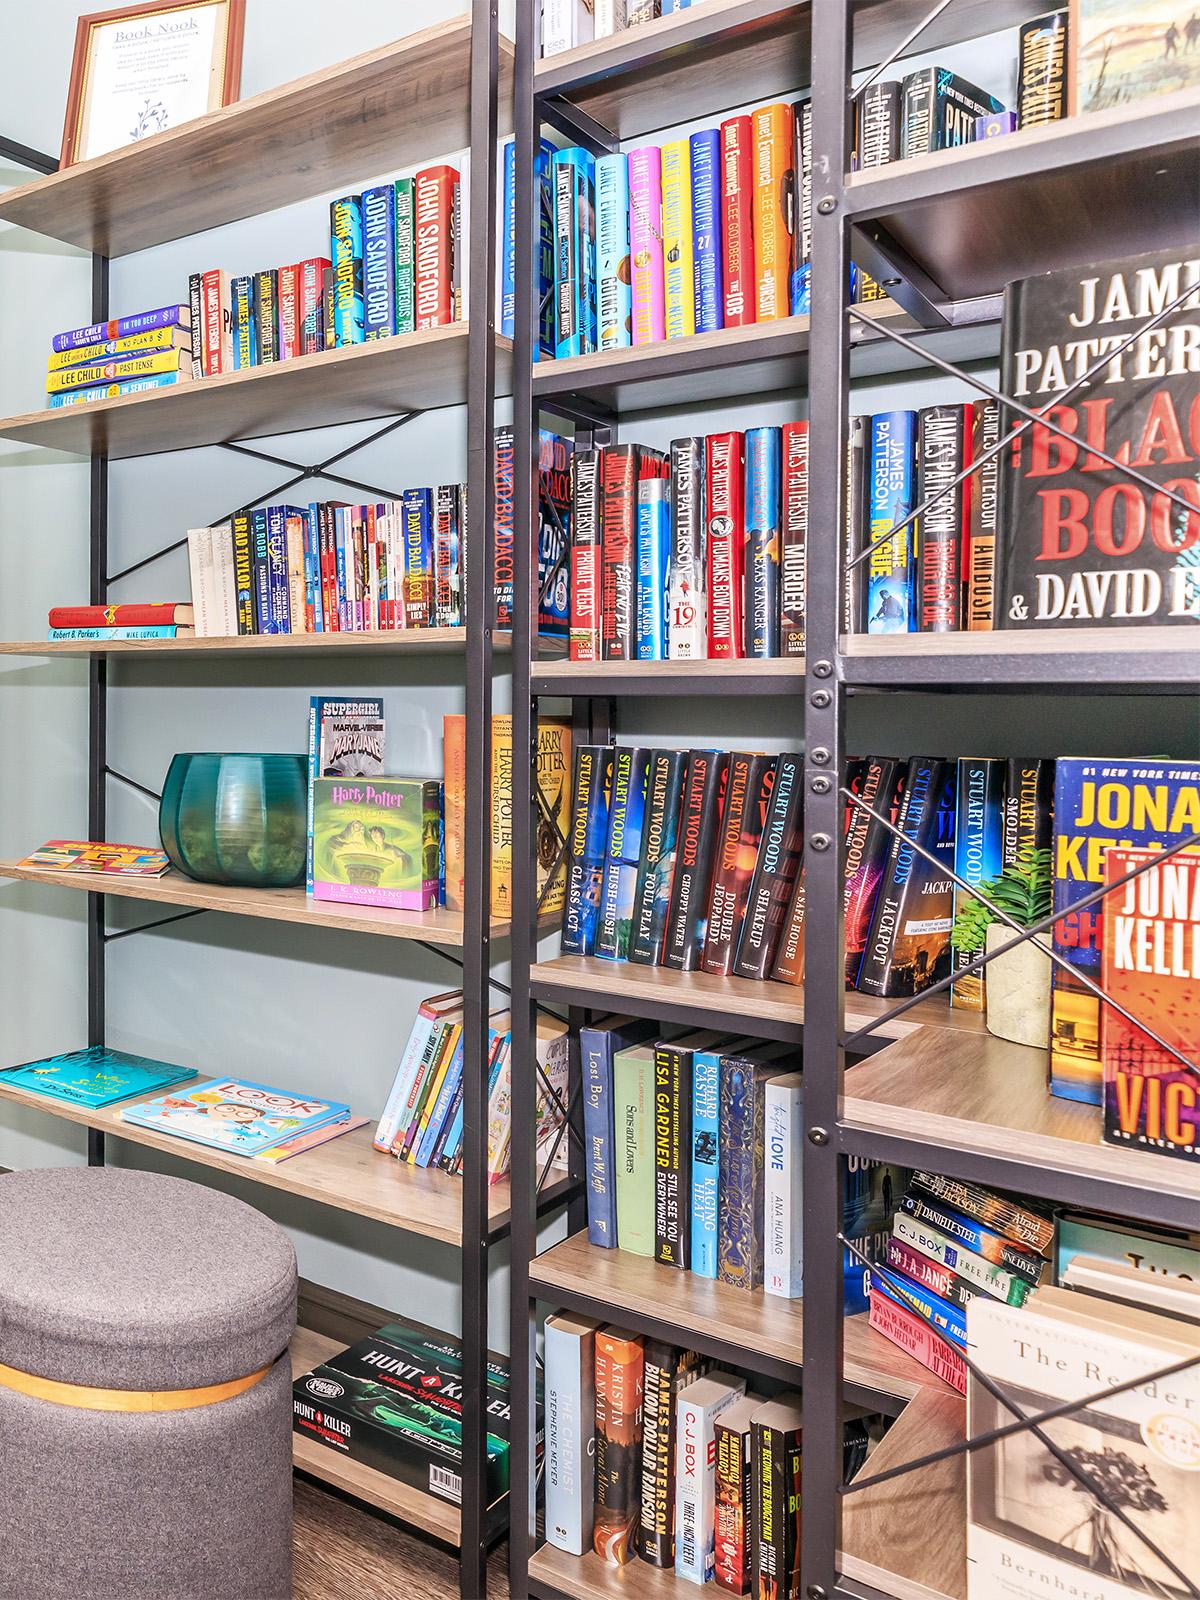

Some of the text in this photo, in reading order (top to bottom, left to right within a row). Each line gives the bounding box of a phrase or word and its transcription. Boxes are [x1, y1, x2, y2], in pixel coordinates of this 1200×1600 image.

[114, 26, 151, 43] Book
[157, 18, 198, 34] Nook
[724, 123, 741, 196] Janet Evanovich
[758, 113, 774, 188] Janet Evanovich
[600, 165, 617, 256] JANET EVANOVICH
[632, 154, 651, 245] JANET EVANOVICH
[693, 141, 713, 232] JANET EVANOVICH
[365, 193, 389, 324] JOHN SANDFORD
[398, 191, 411, 318] JOHN SANDFORD RIGHTEOUS
[418, 176, 440, 315] JOHN SANDFORD
[698, 235, 710, 250] 27
[727, 202, 740, 273] LEE GOLDBERG
[261, 274, 273, 346] JOHN SANDFORD
[282, 270, 295, 344] JOHN SANDFORD
[305, 264, 316, 334] JOHN SANDFORD
[726, 280, 744, 316] THE JOB
[61, 368, 101, 384] LEE CHILD
[120, 359, 154, 373] PAST TENSE
[874, 421, 891, 510] PATTERSON
[890, 439, 904, 491] JAMES
[1025, 390, 1200, 478] BLA
[577, 461, 595, 541] JAMES PATTERSON
[605, 453, 633, 564] JAMES PATTERSON
[712, 440, 728, 513] JAMES PATTERSON
[788, 431, 809, 531] JAMES PATTERSON
[924, 414, 957, 534] JAMES PATTERSON
[271, 513, 283, 576] TOM CLANCY
[495, 448, 514, 584] DAVID BALDACCI
[676, 447, 693, 575] JAMES PATTERSON
[235, 518, 250, 590] BRAD TAYLOR
[407, 512, 422, 601] DAVID BALDACCI
[784, 543, 805, 613] MURDER
[870, 518, 893, 578] ROGUE
[407, 603, 426, 611] SIMPLY
[411, 611, 422, 619] LIES
[494, 587, 501, 595] TO
[577, 551, 594, 618] PRIVATE VEGAS
[1009, 568, 1162, 622] & DAVID
[323, 702, 380, 715] SUPERGIRL
[332, 786, 404, 808] Harry Potter
[573, 753, 592, 857] STUART WOODS
[611, 753, 631, 858] STUART WOODS
[647, 757, 669, 864] STUART WOODS
[683, 758, 707, 867] STUART WOODS
[723, 761, 749, 871] STUART WOODS
[763, 762, 796, 875] STUART WOODS
[1005, 797, 1019, 864] SMOLDER
[1019, 768, 1038, 836] STUART
[568, 865, 583, 932] CLASS ACT
[604, 865, 620, 936] HUSH-HUSH
[639, 873, 657, 940] FOUL PLAY
[674, 873, 692, 947] CHOPPY WATER
[708, 883, 726, 945] JEOPARDY
[720, 892, 736, 942] DOUBLE
[749, 888, 771, 948] SHAKEUP
[872, 897, 899, 966] JACKPOT
[218, 1084, 322, 1113] LOOK
[588, 1051, 603, 1108] Lost Boy
[656, 1052, 670, 1167] LISA GARDNER
[695, 1063, 708, 1118] CASTLE
[706, 1066, 717, 1119] RICHARD
[770, 1135, 784, 1170] LOVE
[656, 1171, 668, 1238] EVERYWHERE
[666, 1172, 678, 1243] STILL SEE YOU
[694, 1183, 705, 1221] HEAT
[703, 1177, 716, 1232] RAGING
[773, 1196, 783, 1255] ANA HUANG
[922, 1207, 978, 1245] DANIELLE STEEL
[1012, 1212, 1042, 1232] Afraid
[959, 1259, 1007, 1292] FREE FIRE
[361, 1350, 436, 1386] HUNT A
[595, 1358, 607, 1421] HANNAH
[610, 1363, 624, 1427] KRISTIN
[1013, 1339, 1196, 1410] The Reder
[549, 1390, 558, 1486] STEPHENIE MEYER
[640, 1362, 659, 1532] BILLION DOLLAR RANSOM
[655, 1369, 671, 1535] JAMES PATTERSON
[1000, 1552, 1106, 1600] Bernhard
